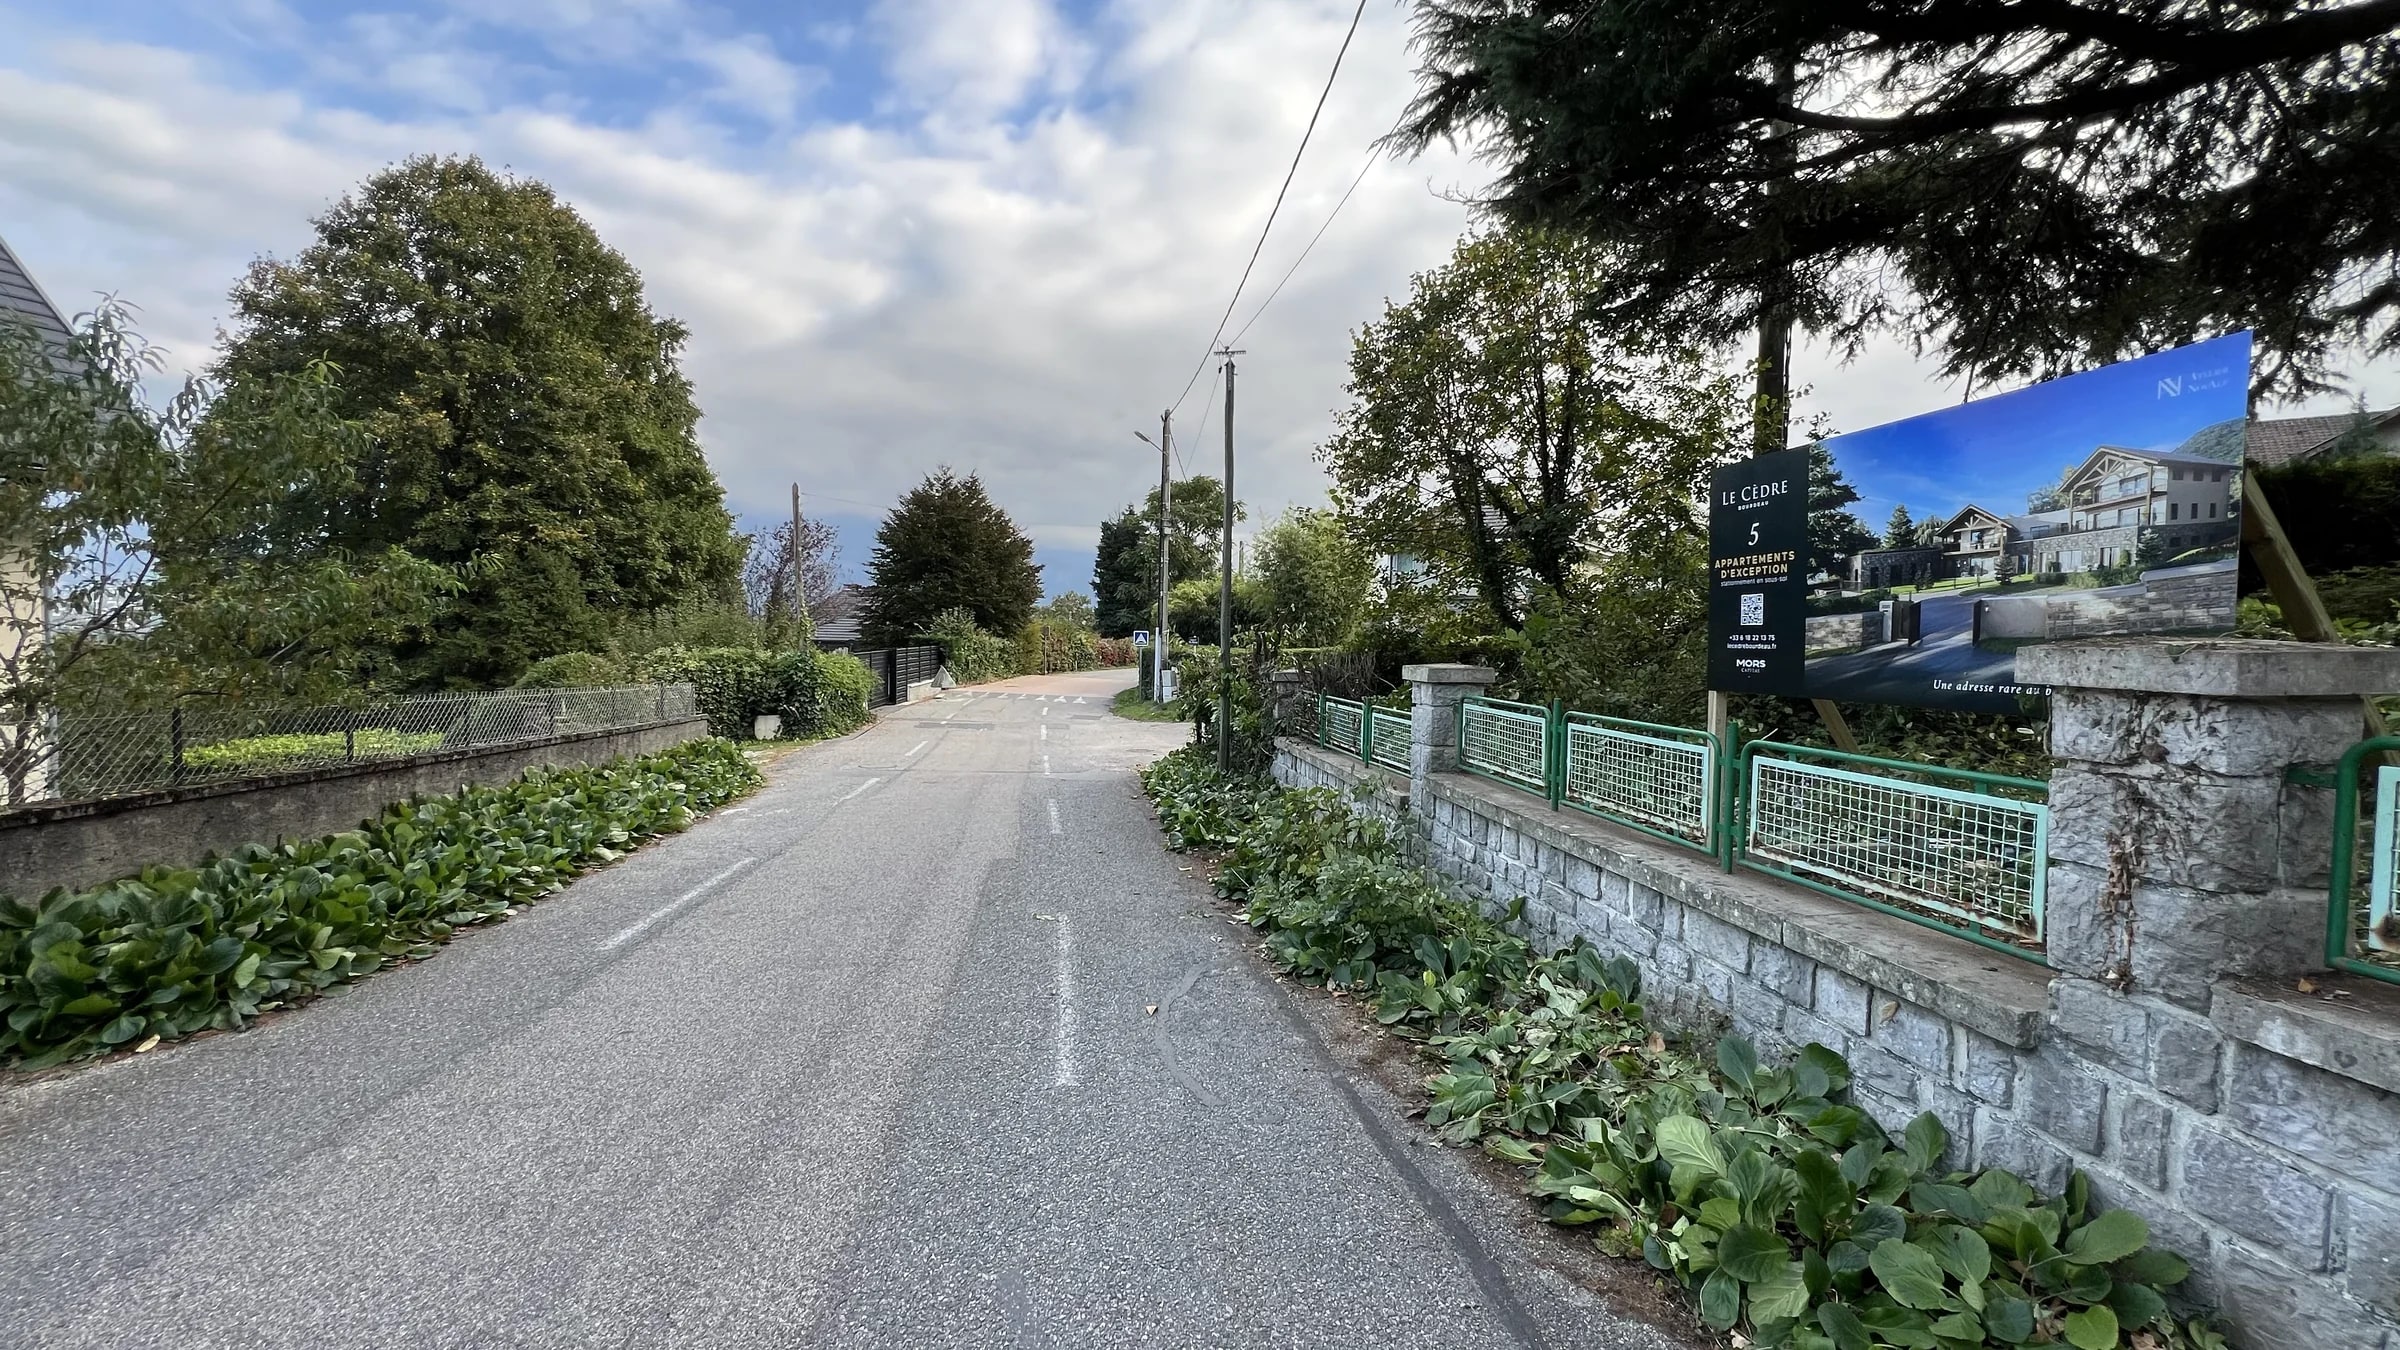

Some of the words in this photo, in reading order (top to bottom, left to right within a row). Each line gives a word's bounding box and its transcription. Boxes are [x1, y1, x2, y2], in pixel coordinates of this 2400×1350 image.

[1738, 501, 1769, 511] BOURDEAU
[1748, 522, 1760, 546] 5
[1714, 551, 1796, 569] APPARTEMENTS
[1720, 563, 1788, 579] D'EXCEPTION
[1736, 659, 1766, 668] MORS
[1933, 680, 1953, 690] Une
[1956, 681, 1994, 692] adresse
[1998, 685, 2022, 694] rare
[2026, 687, 2041, 695] au
